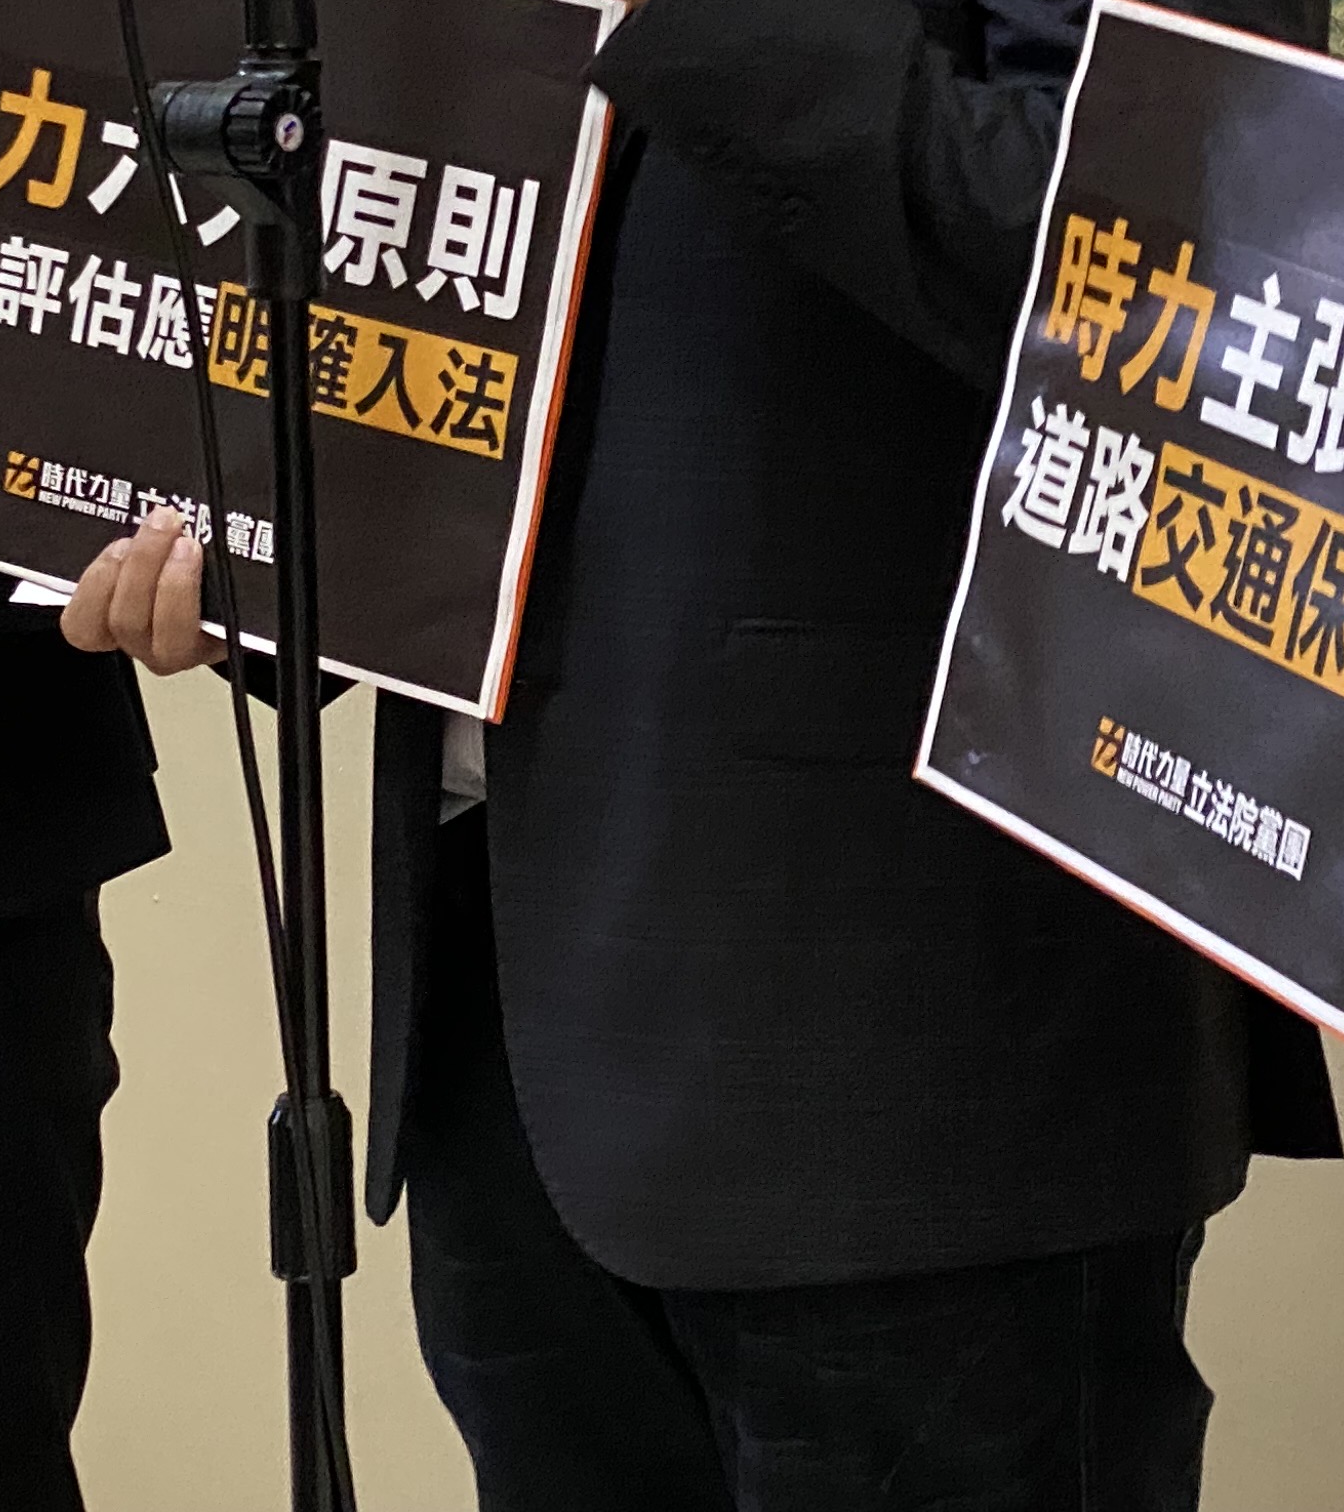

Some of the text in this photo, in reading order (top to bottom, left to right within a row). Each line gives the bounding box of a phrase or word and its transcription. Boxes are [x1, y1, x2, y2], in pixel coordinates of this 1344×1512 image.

[38, 489, 130, 524] NEW POWER PARTY
[40, 460, 133, 510] 時代力量
[1121, 730, 1311, 881] 時代力量 立法院黨團
